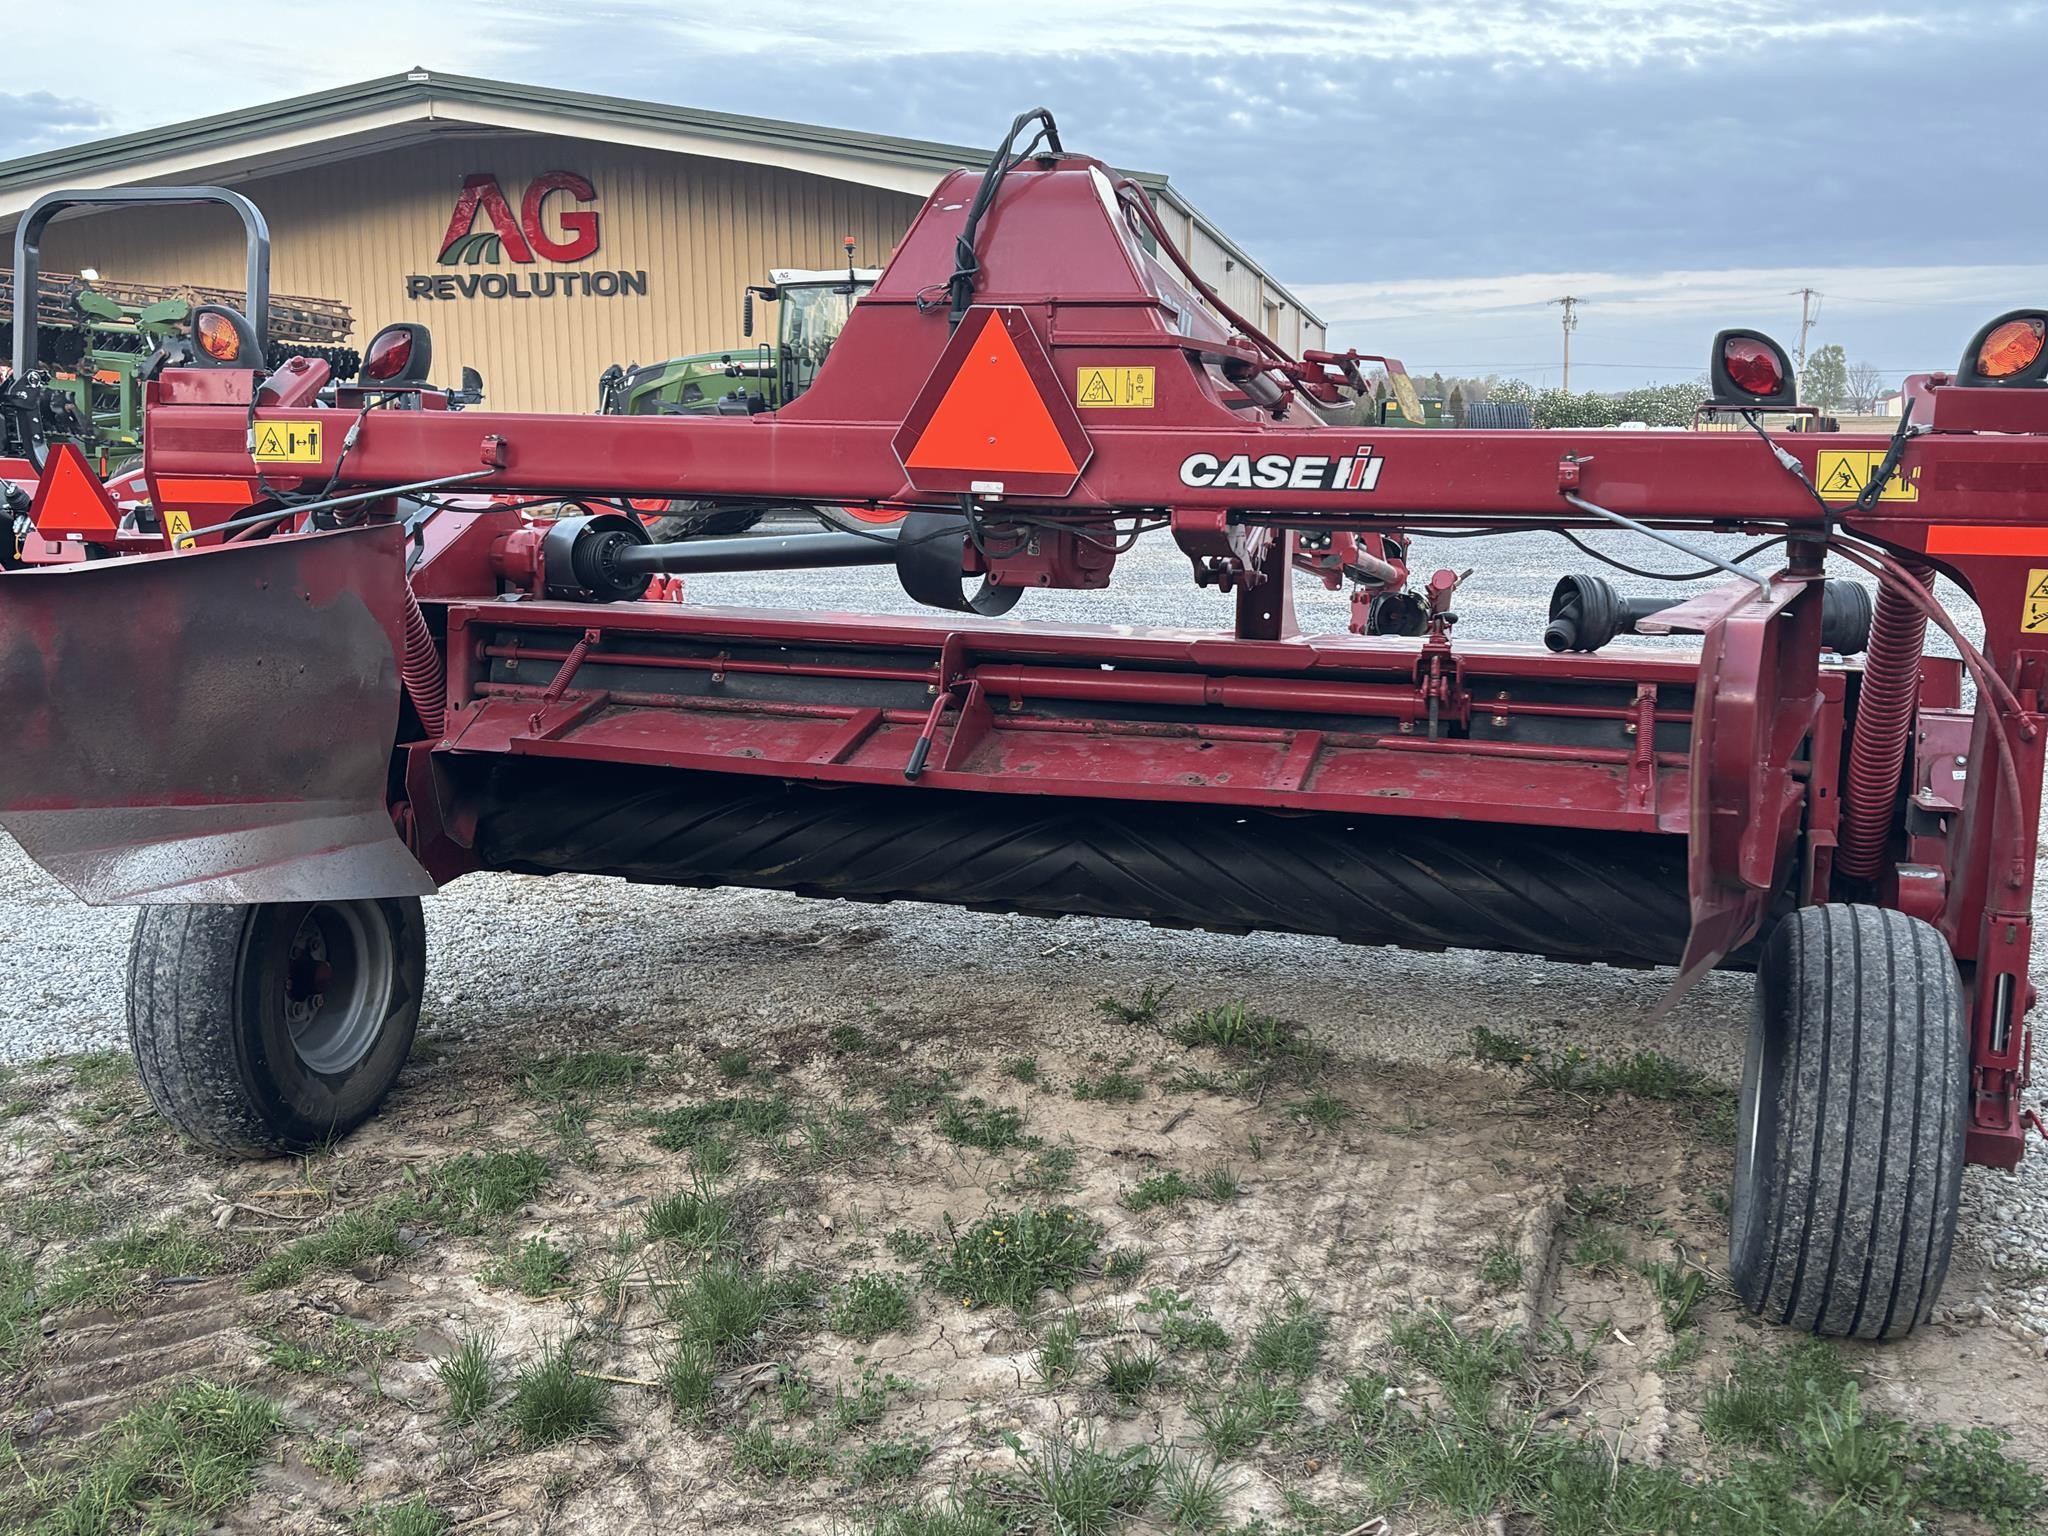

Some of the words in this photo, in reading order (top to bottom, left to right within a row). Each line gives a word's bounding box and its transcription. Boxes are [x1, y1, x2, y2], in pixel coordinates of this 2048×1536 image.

[437, 170, 600, 265] AG
[406, 271, 647, 300] REVOLUTION
[1179, 453, 1329, 488] CASE
